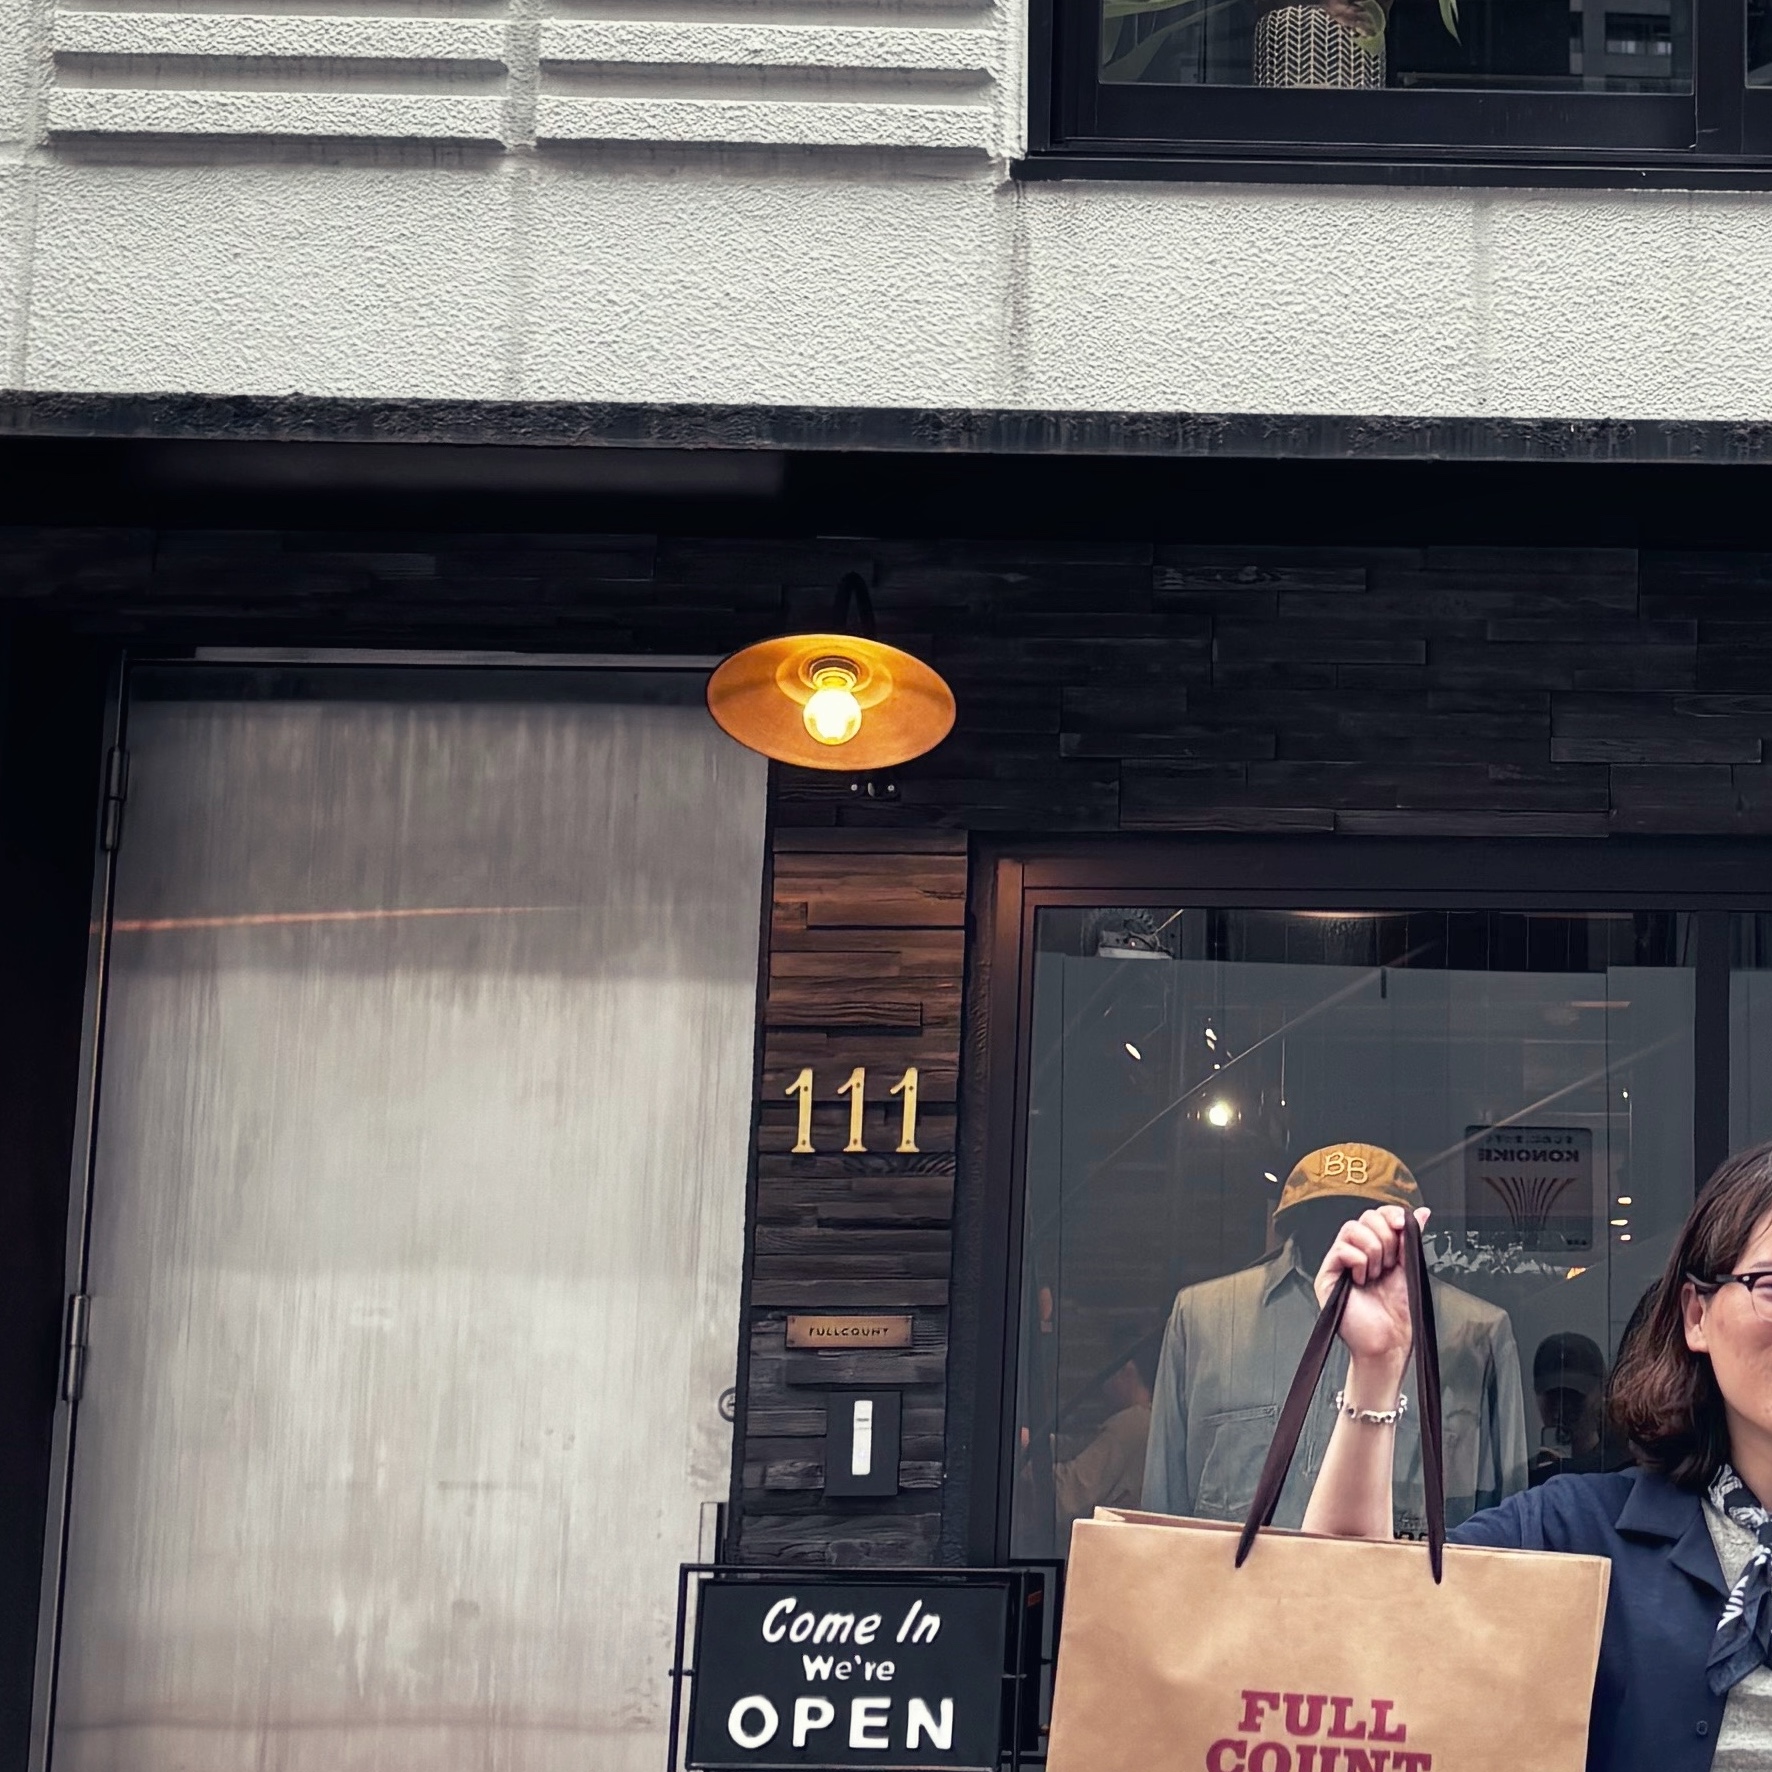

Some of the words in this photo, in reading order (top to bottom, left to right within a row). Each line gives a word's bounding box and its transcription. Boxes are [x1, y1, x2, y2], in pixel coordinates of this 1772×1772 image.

[785, 1067, 920, 1153] 111
[809, 1327, 889, 1337] FULLCOUNT
[762, 1597, 881, 1645] Come
[896, 1600, 941, 1643] In
[802, 1654, 895, 1681] We're
[728, 1695, 954, 1749] OPEN
[1238, 1690, 1406, 1742] FULL
